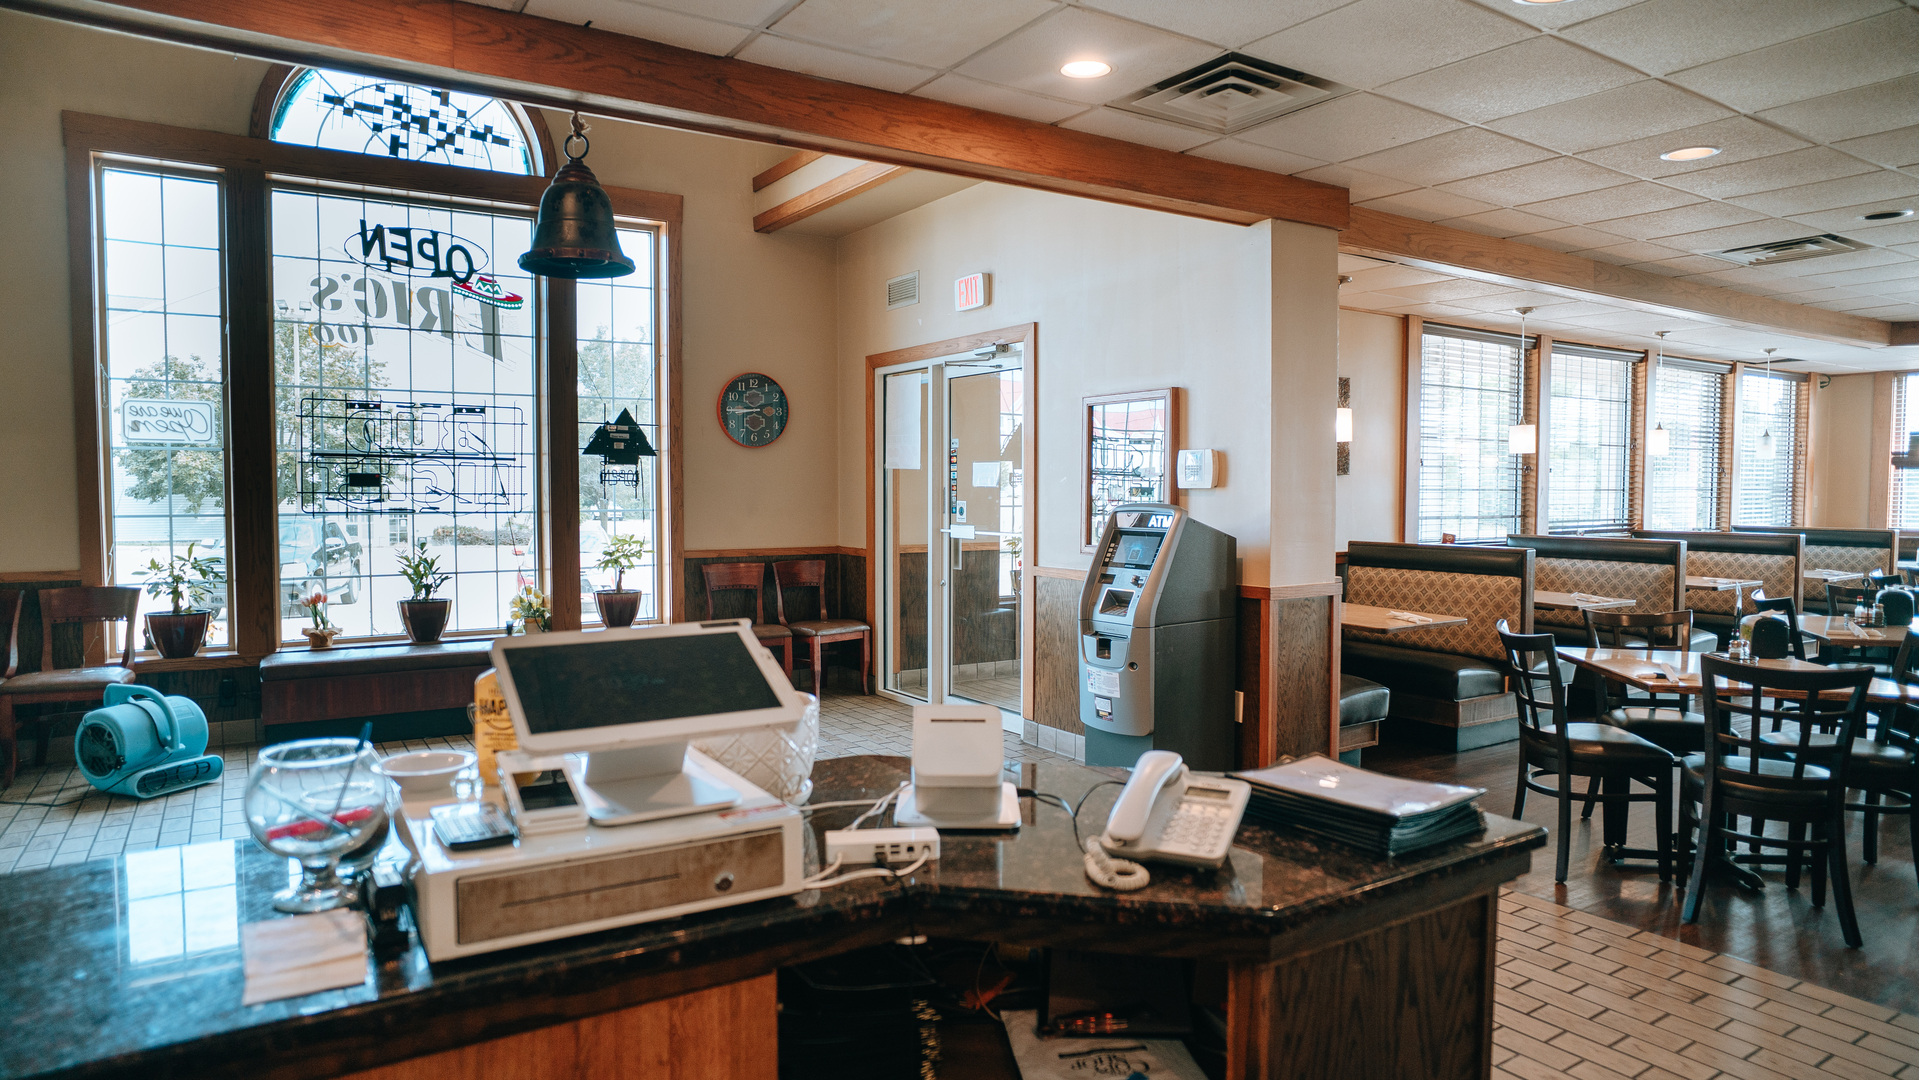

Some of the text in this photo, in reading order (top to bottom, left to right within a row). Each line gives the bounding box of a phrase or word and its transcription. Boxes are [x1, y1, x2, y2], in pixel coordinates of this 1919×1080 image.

[958, 275, 979, 308] EXIT
[738, 383, 745, 391] 11
[749, 379, 758, 387] 12
[729, 392, 738, 401] 10
[773, 393, 779, 401] 2
[776, 407, 782, 416] 3
[729, 420, 735, 428] 8
[773, 421, 778, 429] 4
[740, 429, 745, 437] 7
[751, 433, 757, 441] 6
[764, 430, 770, 438] 5
[1148, 514, 1173, 528] ATM
